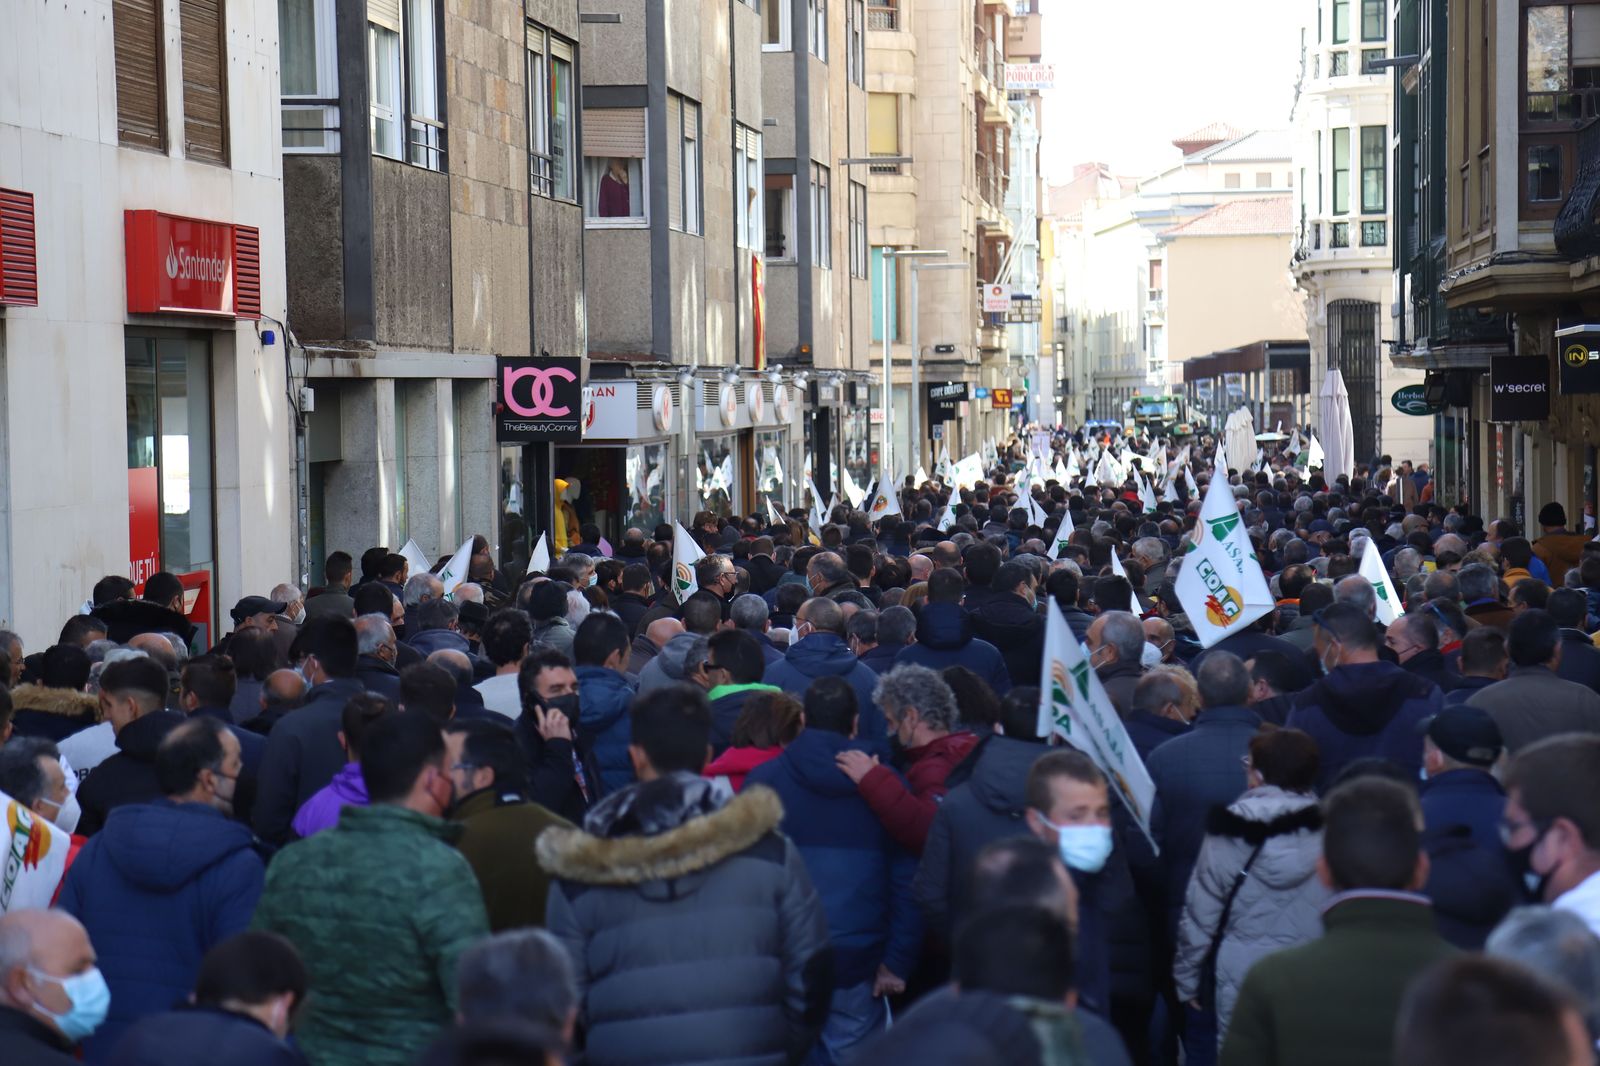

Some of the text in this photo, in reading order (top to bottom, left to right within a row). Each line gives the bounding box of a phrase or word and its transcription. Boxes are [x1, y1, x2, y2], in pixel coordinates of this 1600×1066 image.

[179, 247, 225, 282] Santander
[504, 423, 578, 433] TheBeautyCorner
[1196, 558, 1241, 618] COAG
